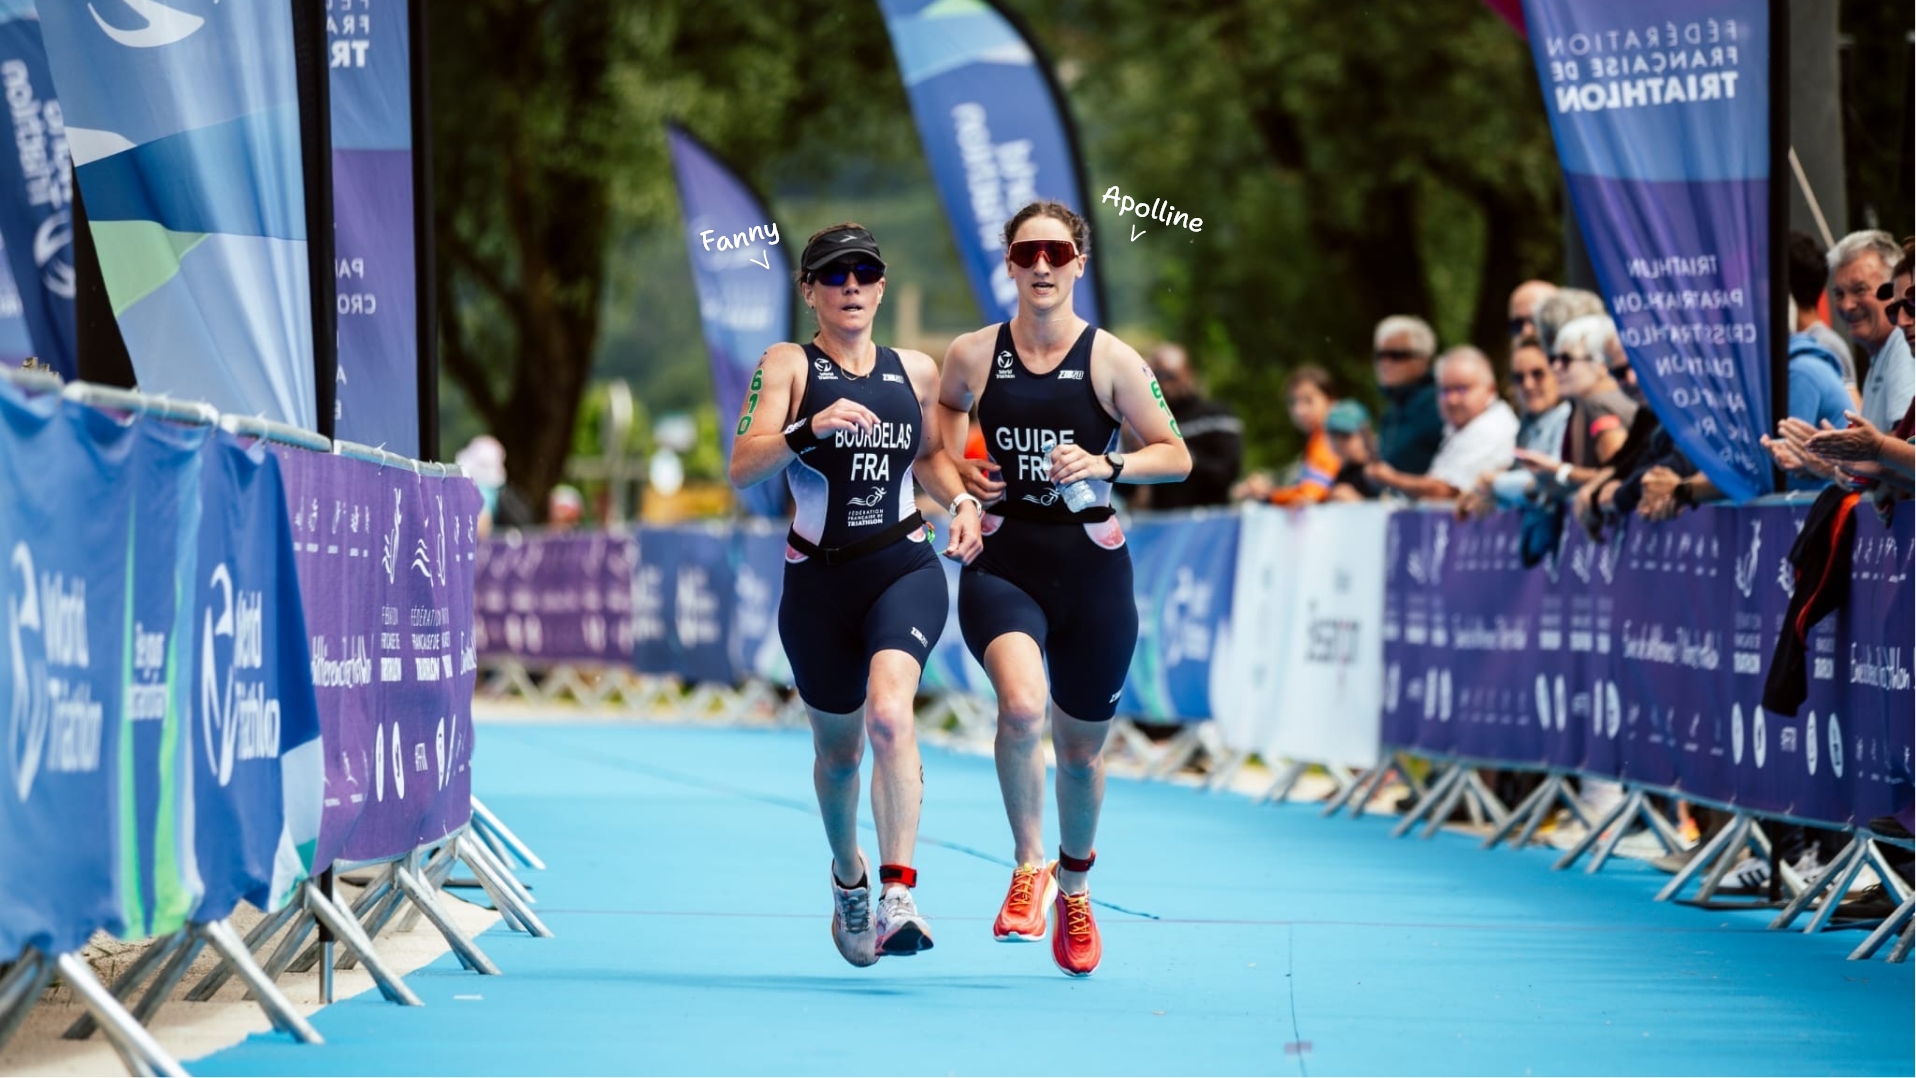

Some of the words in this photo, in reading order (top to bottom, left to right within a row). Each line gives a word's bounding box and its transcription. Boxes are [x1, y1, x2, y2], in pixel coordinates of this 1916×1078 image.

[835, 422, 912, 450] BOURDELAS
[995, 426, 1075, 453] GUIDE
[850, 453, 890, 481] FRA
[1018, 454, 1050, 482] FR
[848, 518, 884, 527] TRIATHLON
